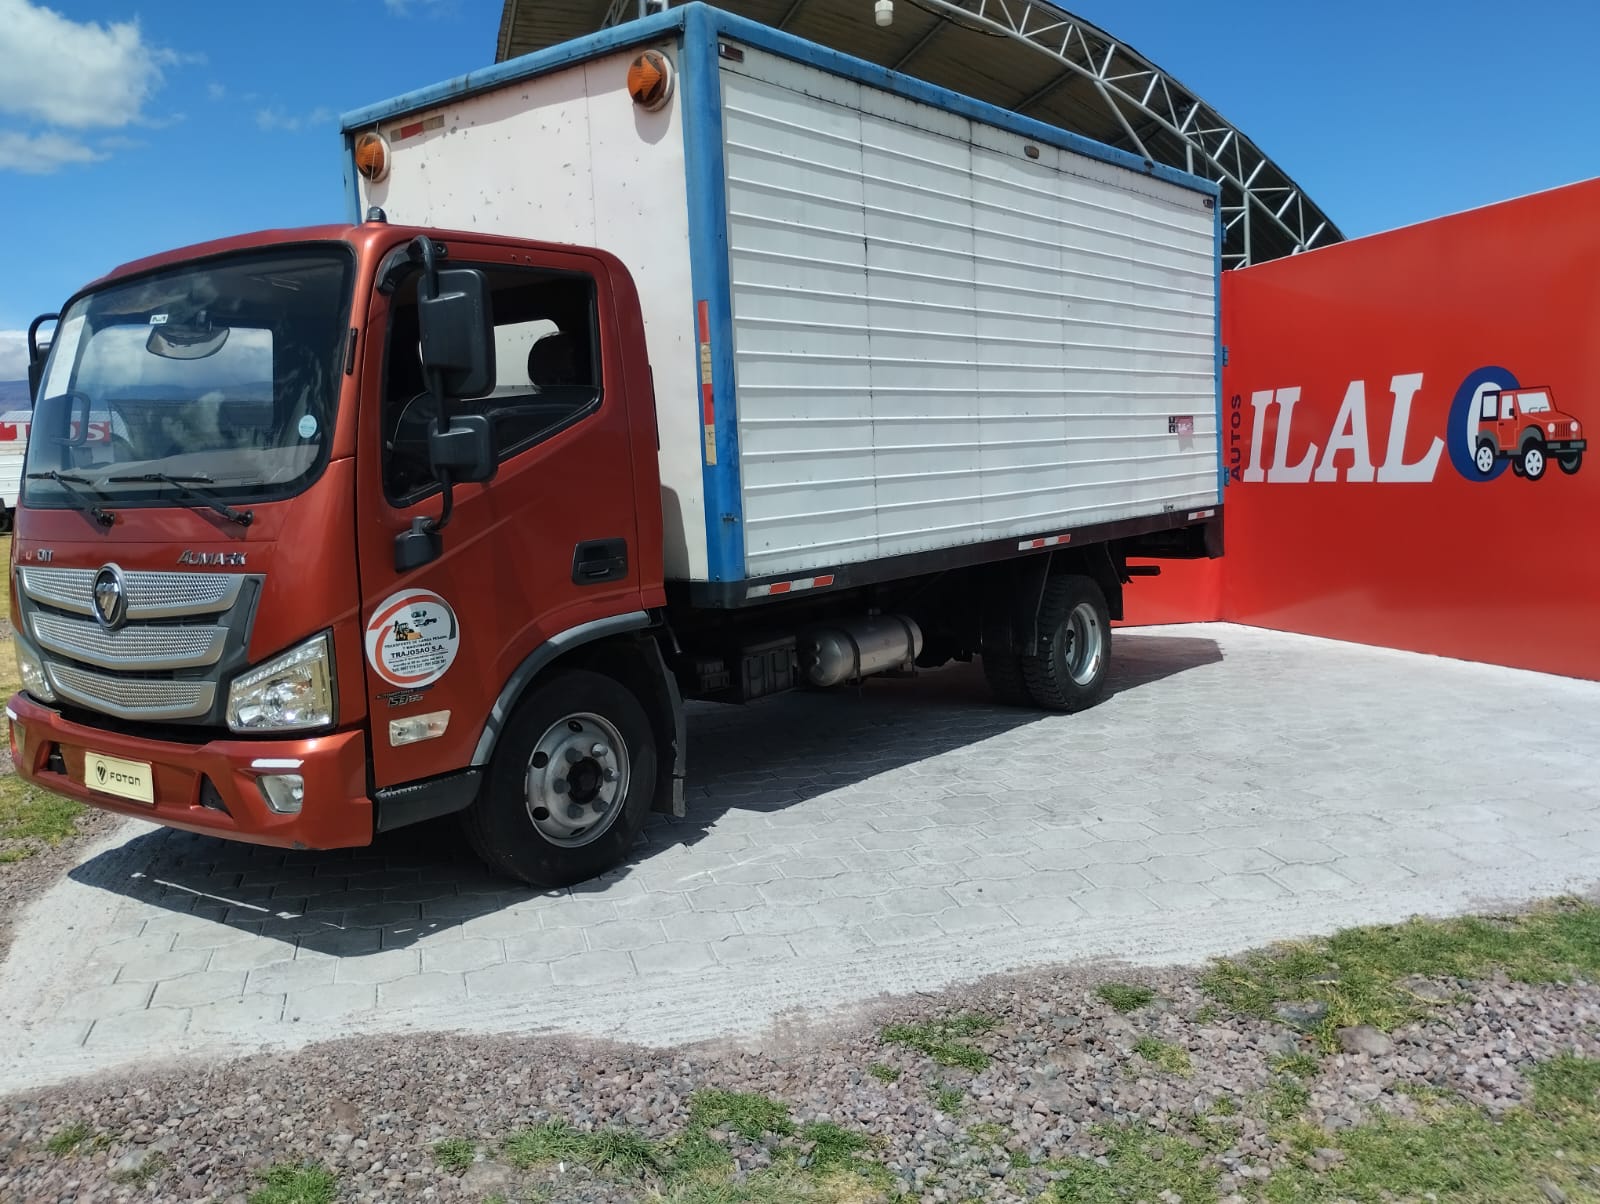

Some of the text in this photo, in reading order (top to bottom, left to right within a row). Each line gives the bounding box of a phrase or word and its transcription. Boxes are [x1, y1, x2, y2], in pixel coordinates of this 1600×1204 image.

[1230, 394, 1242, 482] AUTOS
[391, 647, 430, 659] TRAJOSAO
[109, 771, 141, 787] FOTON
